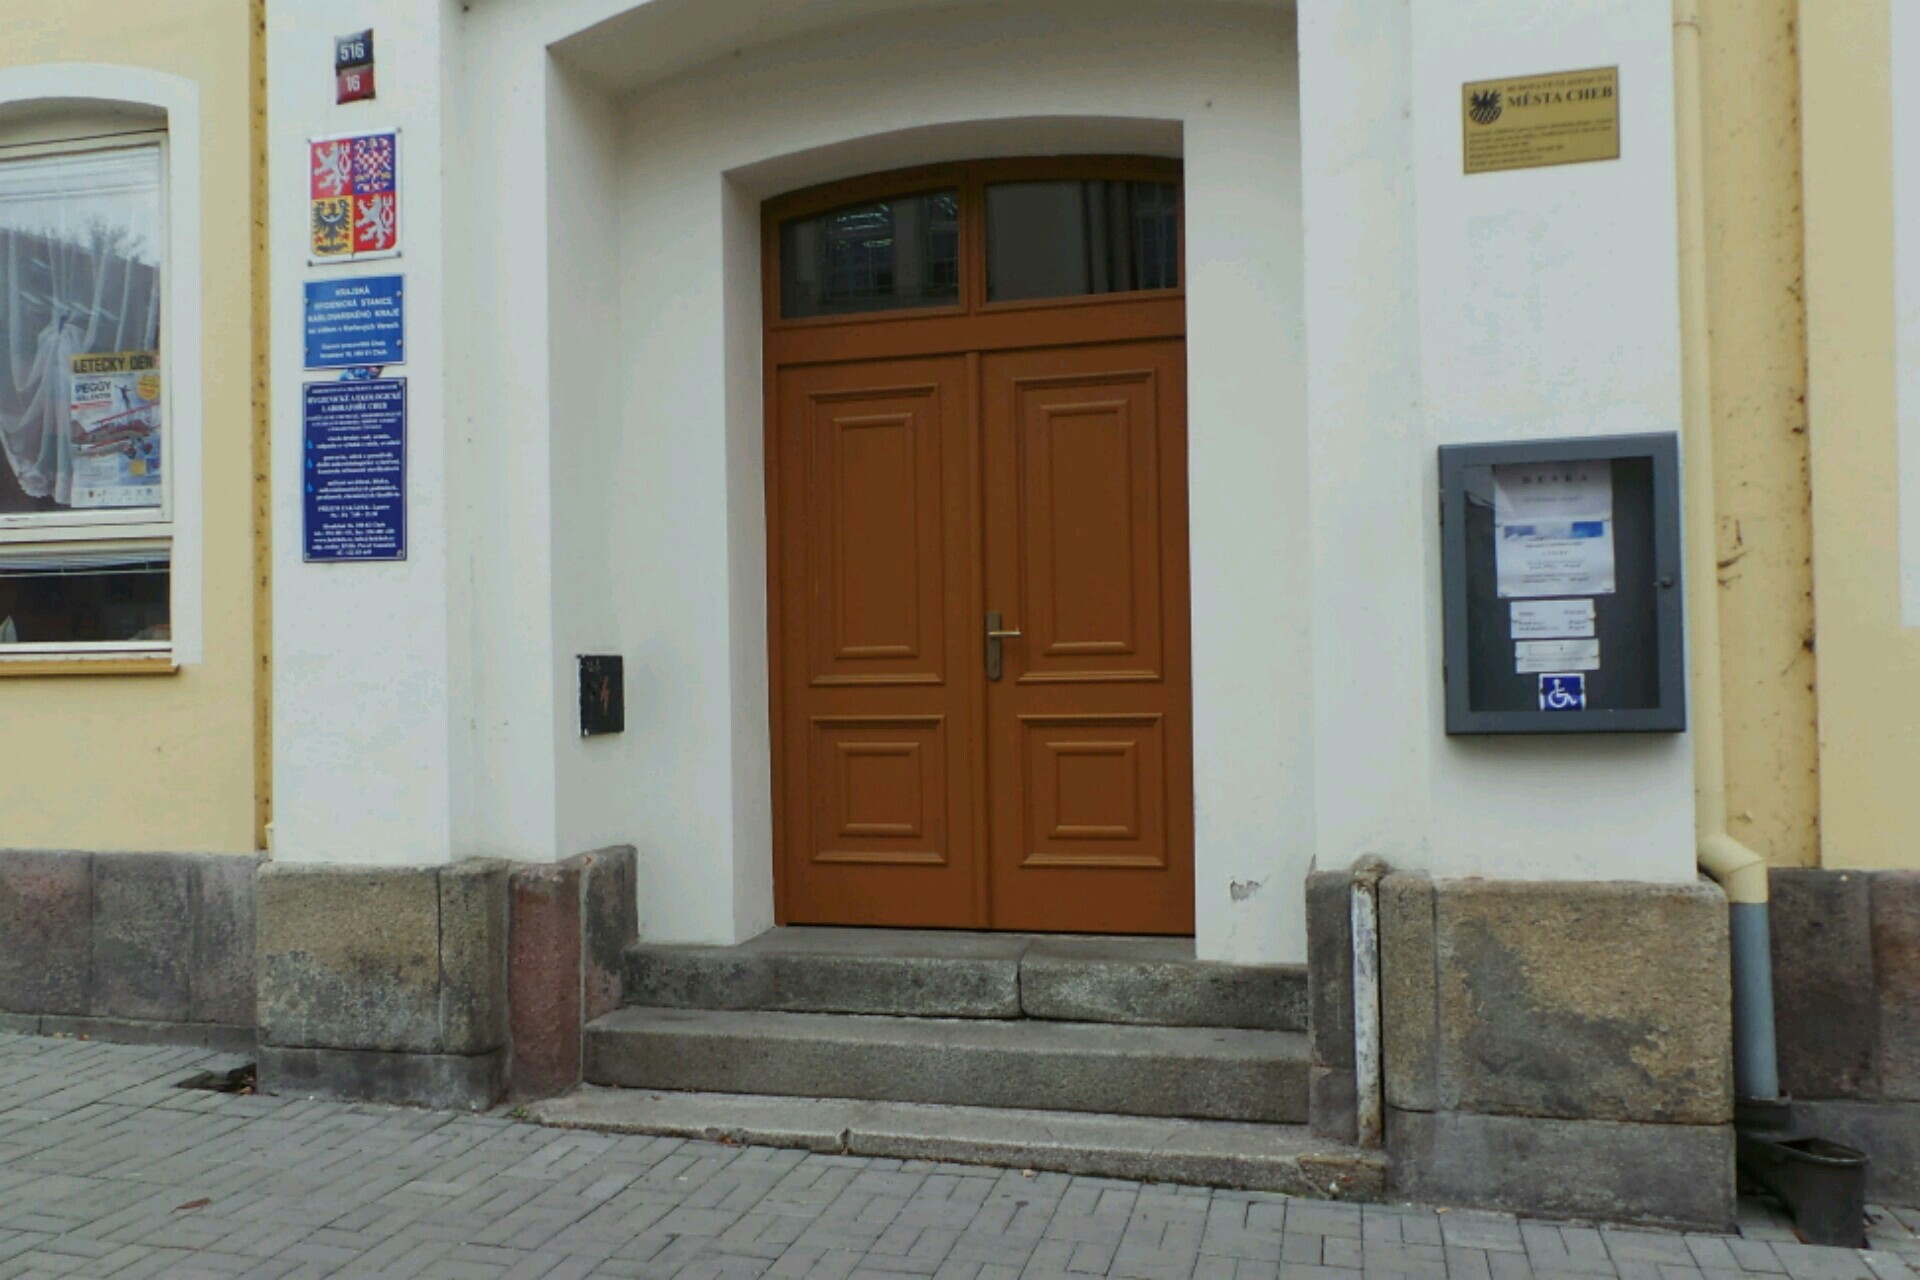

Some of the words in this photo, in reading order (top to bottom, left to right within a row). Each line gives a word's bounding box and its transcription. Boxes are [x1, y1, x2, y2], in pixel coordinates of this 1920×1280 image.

[341, 43, 364, 61] 516
[346, 74, 360, 92] 16
[1566, 85, 1613, 101] CHEB
